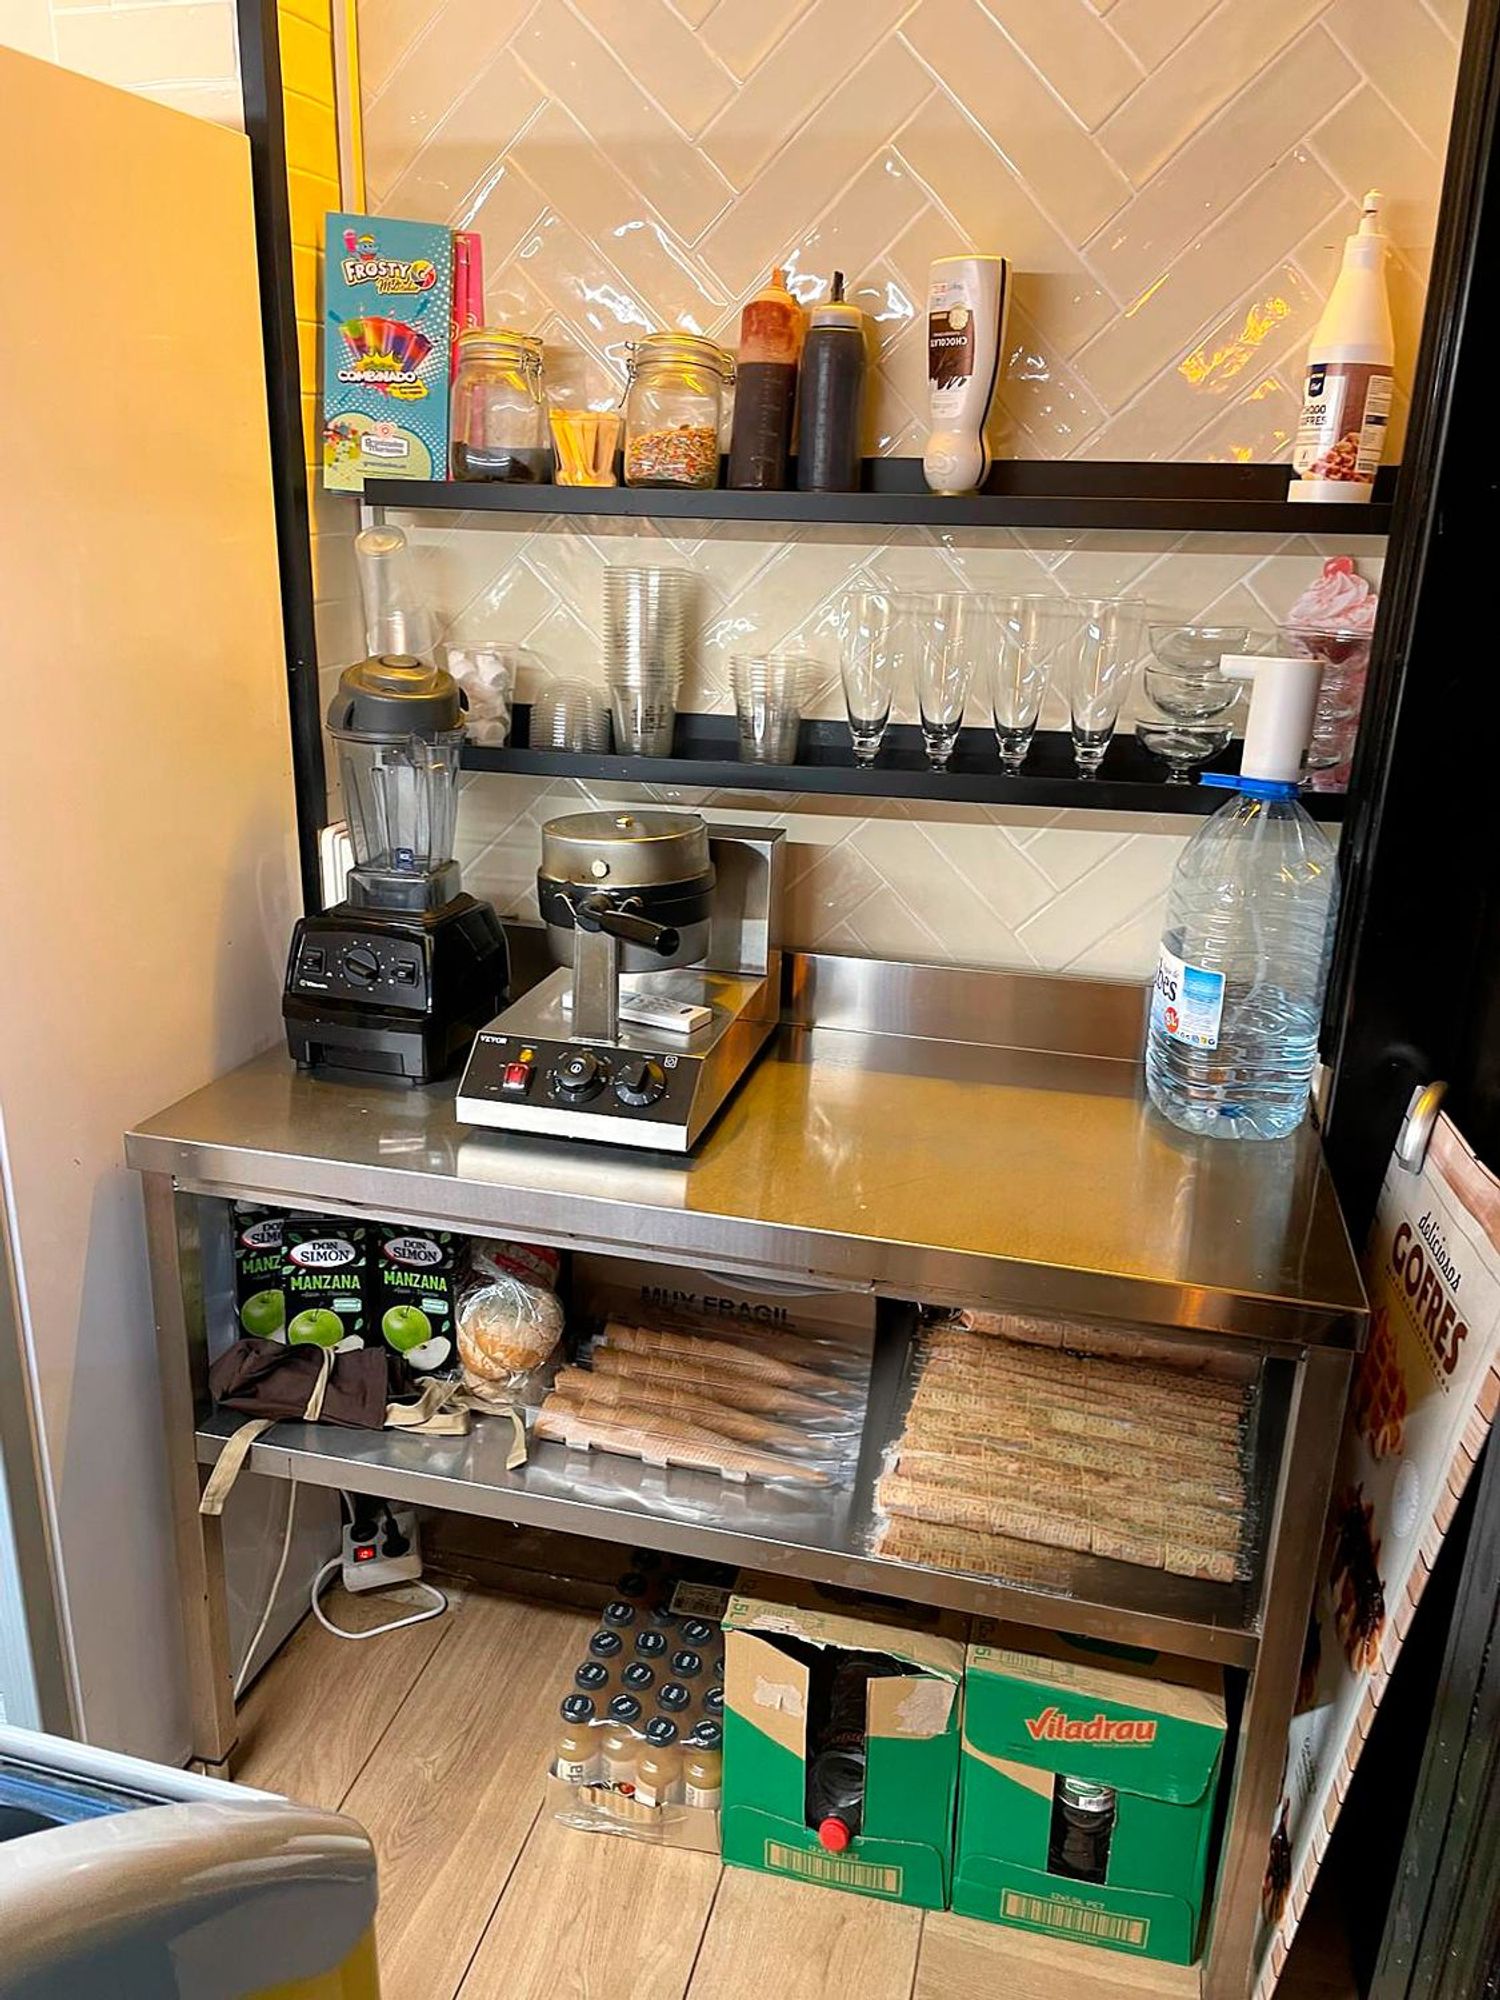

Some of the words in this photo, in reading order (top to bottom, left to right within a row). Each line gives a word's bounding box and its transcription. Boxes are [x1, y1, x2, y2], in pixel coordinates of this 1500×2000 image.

[345, 261, 409, 284] FROSTY
[338, 370, 416, 384] COMBINADO
[262, 1222, 280, 1231] DO
[251, 1232, 281, 1244] SIM
[312, 1242, 338, 1250] DON
[404, 1239, 427, 1249] DON
[300, 1250, 350, 1262] SIMON
[393, 1246, 438, 1262] SIMON
[1418, 1211, 1462, 1293] deliciosos
[242, 1254, 281, 1274] MANZ
[290, 1274, 361, 1290] MANZANA
[384, 1270, 448, 1292] MANZANA
[1392, 1221, 1468, 1375] GOFRES
[1024, 1706, 1158, 1742] Viladrau
